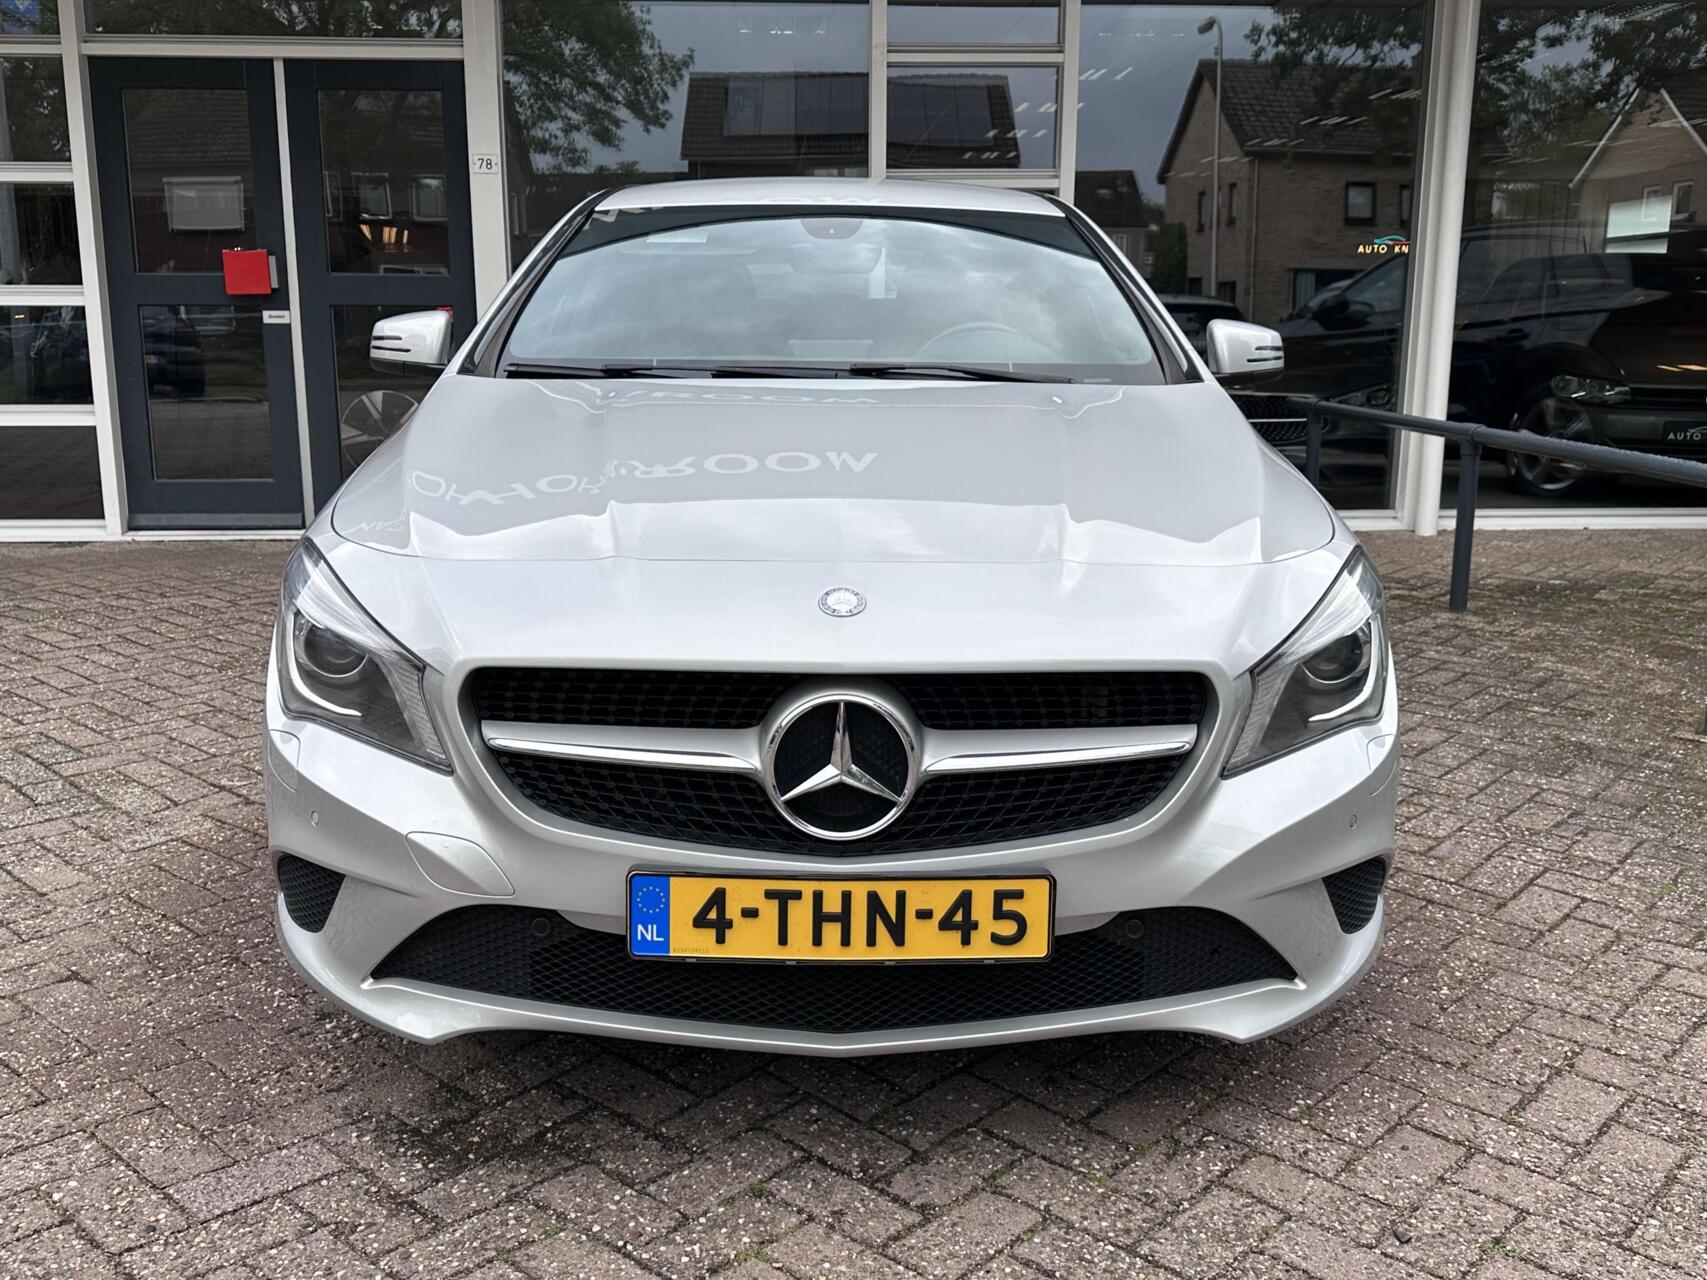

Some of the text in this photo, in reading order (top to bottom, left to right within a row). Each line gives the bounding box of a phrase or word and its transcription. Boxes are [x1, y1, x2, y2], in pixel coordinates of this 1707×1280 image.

[478, 158, 493, 170] 78
[1357, 244, 1388, 254] AUTO
[1667, 432, 1702, 441] AUTO
[691, 887, 1029, 948] 4-THN-45
[636, 923, 664, 942] NL
